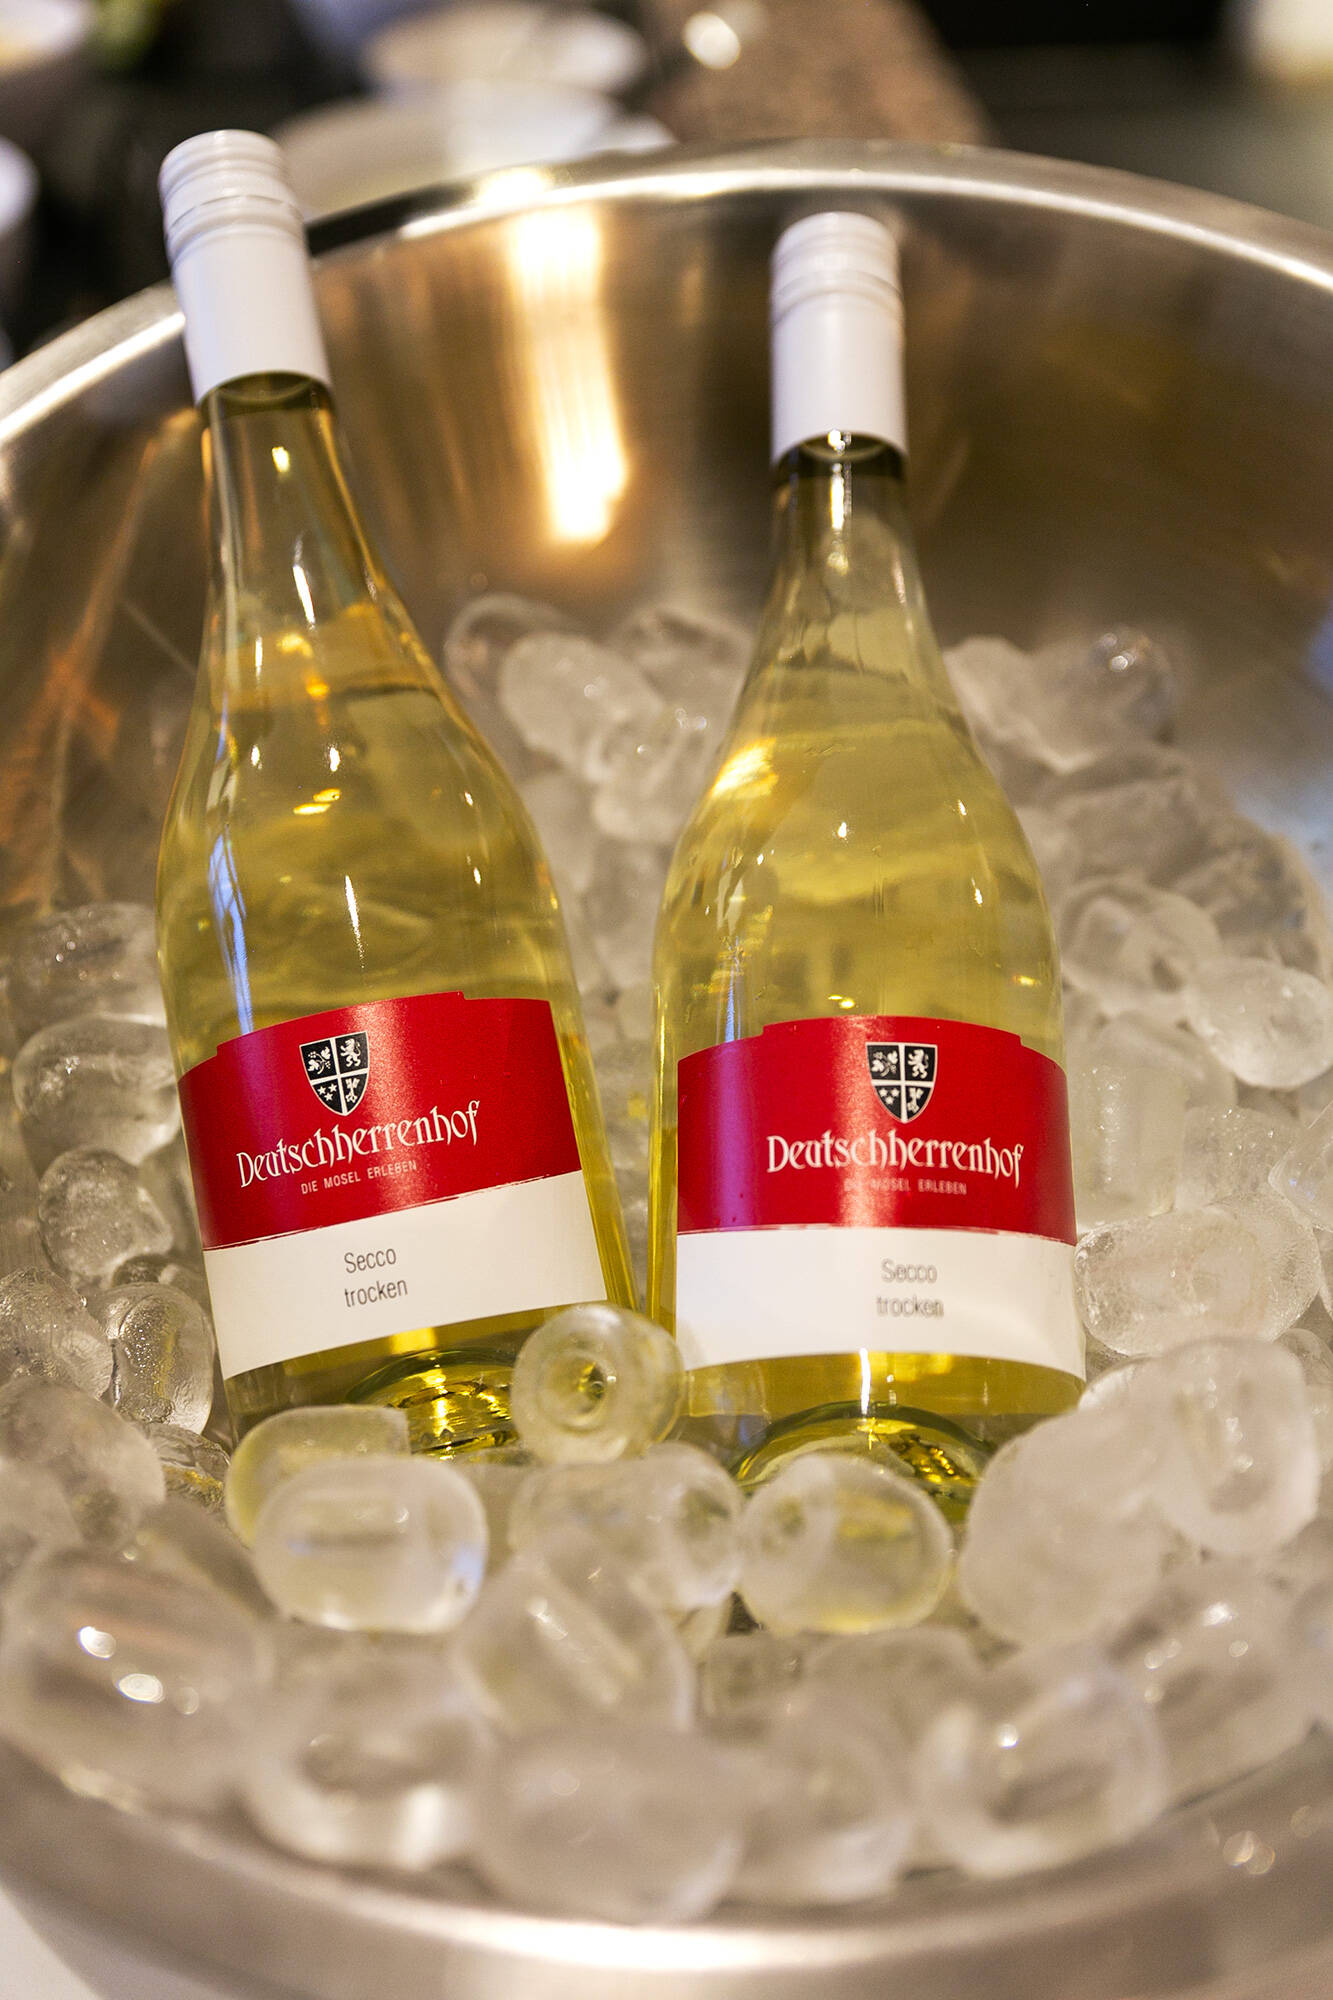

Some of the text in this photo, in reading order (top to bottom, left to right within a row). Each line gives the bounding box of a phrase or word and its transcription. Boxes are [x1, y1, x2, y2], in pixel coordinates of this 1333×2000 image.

[236, 1100, 480, 1188] Deutschherrenhof
[766, 1128, 1025, 1189] Deutschherrenhof
[300, 1160, 417, 1195] DIE MOSEL ERLEBEN
[918, 1178, 967, 1195] ERLEBEN
[344, 1248, 396, 1273] Secco
[881, 1258, 938, 1284] Secco
[344, 1280, 408, 1307] trocken
[876, 1294, 944, 1319] trocken
